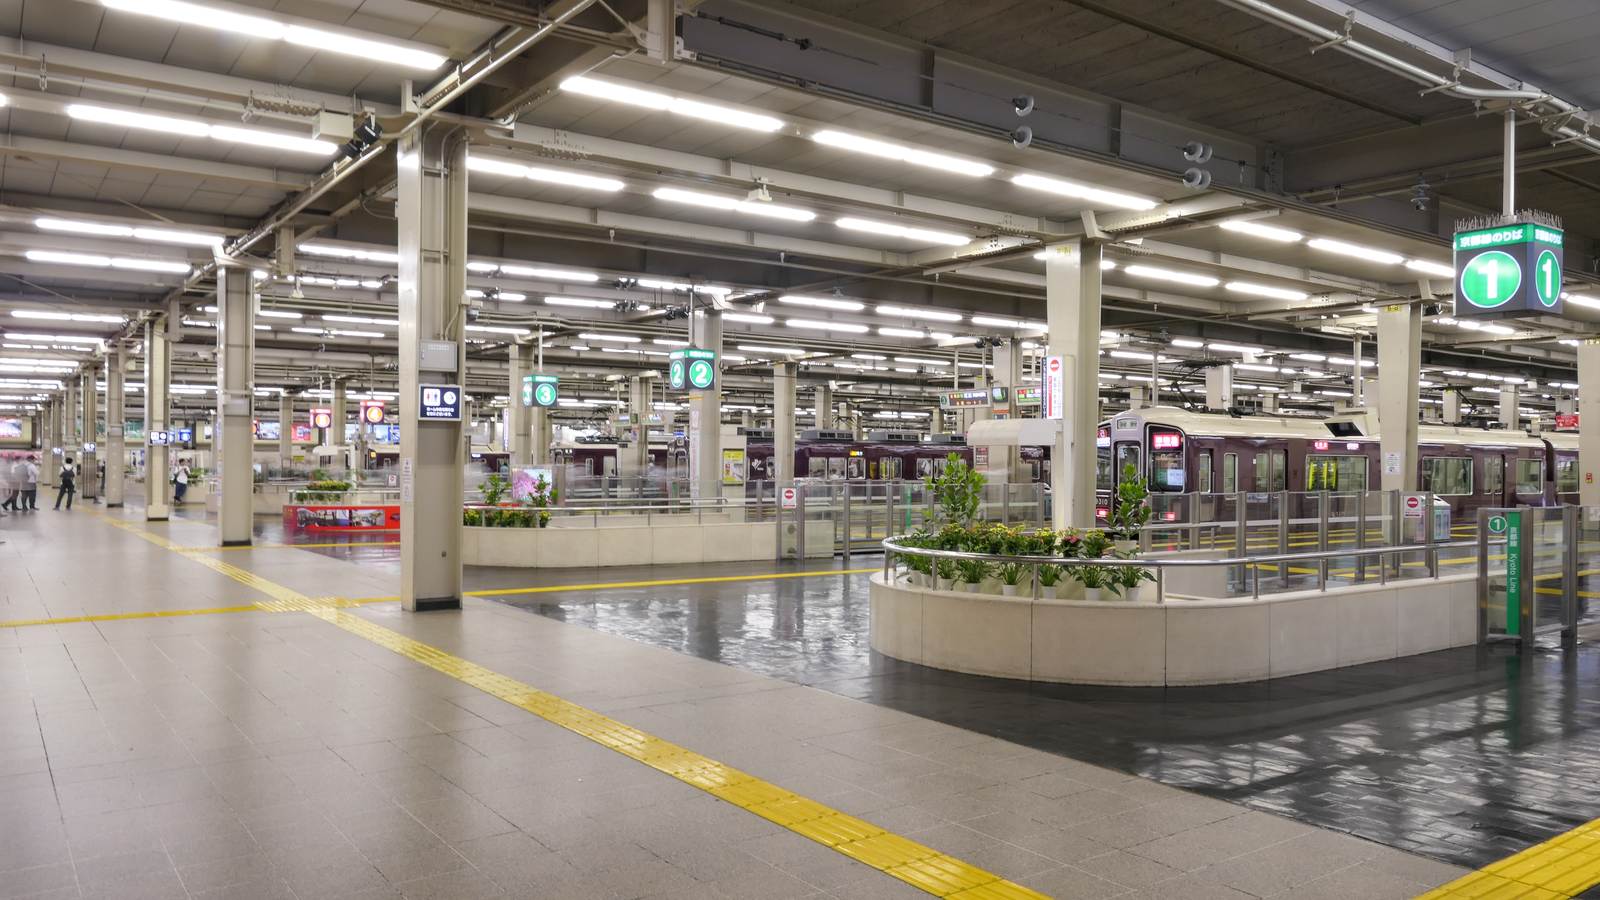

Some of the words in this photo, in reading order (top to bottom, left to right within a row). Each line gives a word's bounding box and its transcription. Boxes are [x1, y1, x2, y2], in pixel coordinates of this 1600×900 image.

[1477, 259, 1498, 299] 1
[1542, 259, 1552, 298] 1
[673, 363, 681, 384] 2
[695, 363, 707, 384] 2
[540, 386, 551, 402] 3
[1494, 519, 1500, 531] 1
[1510, 553, 1518, 575] Kyoto
